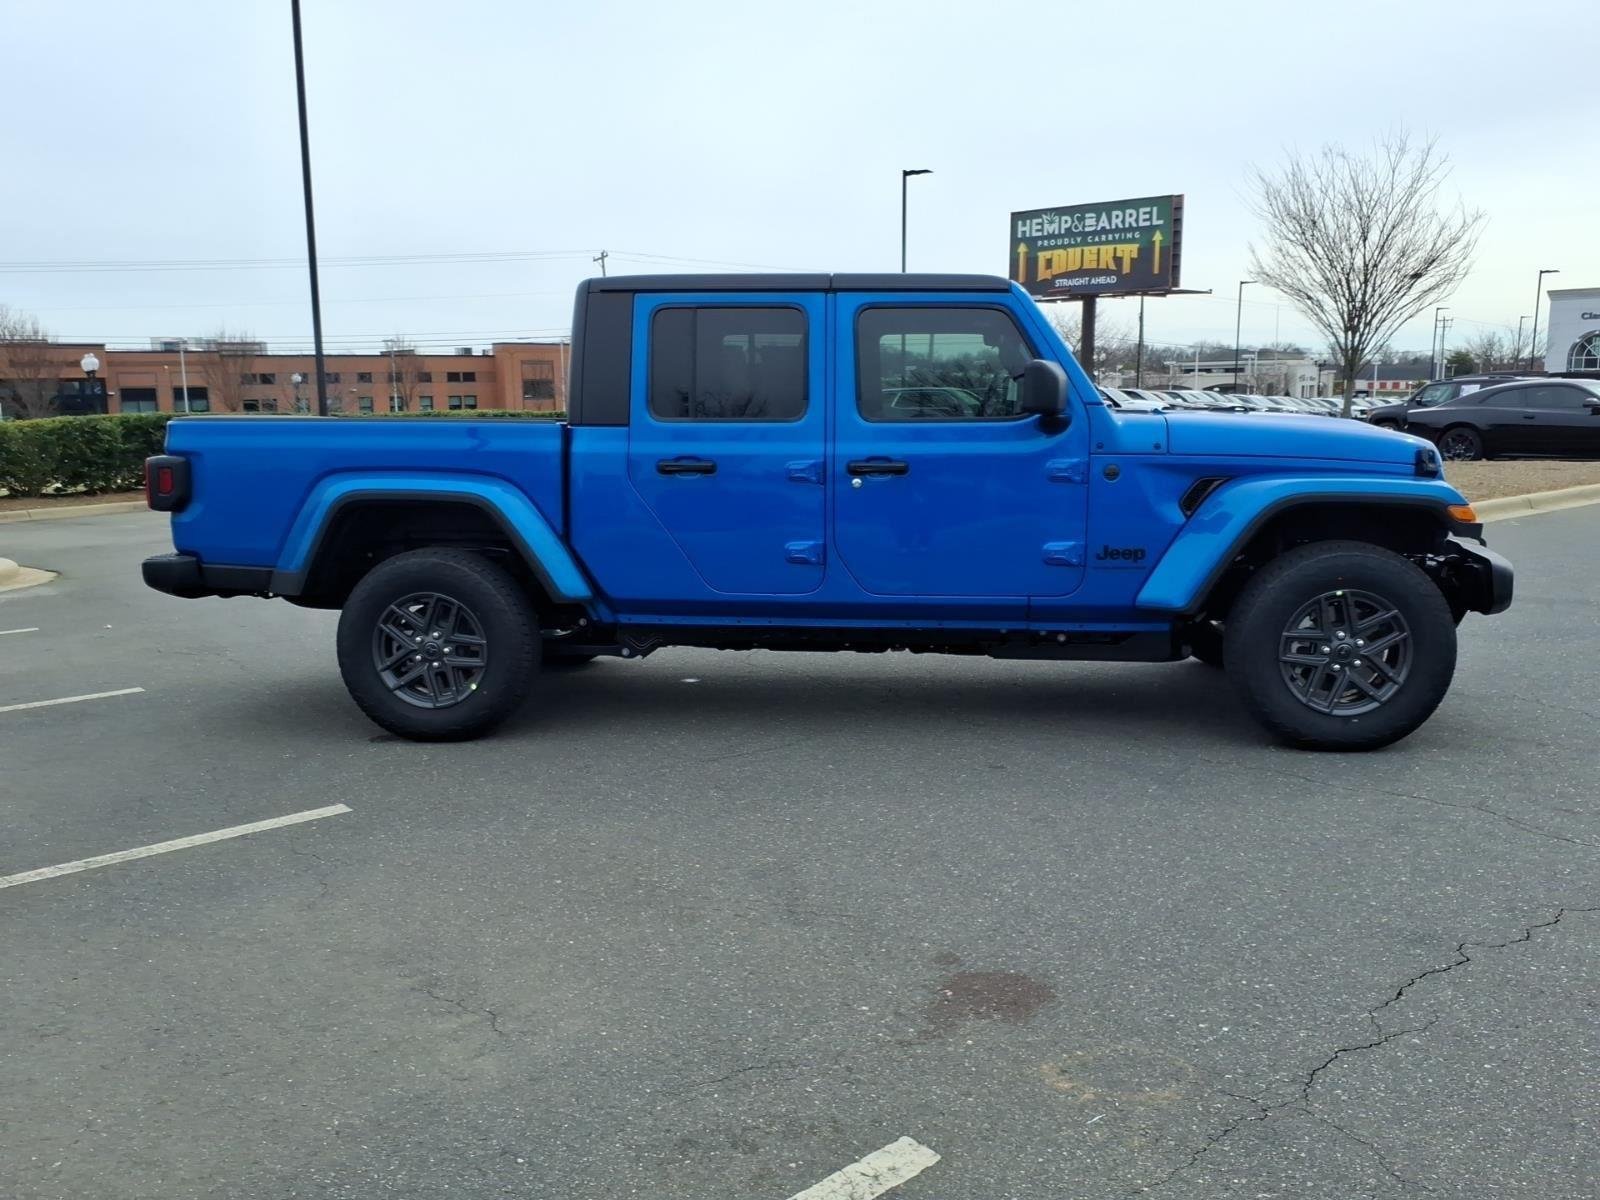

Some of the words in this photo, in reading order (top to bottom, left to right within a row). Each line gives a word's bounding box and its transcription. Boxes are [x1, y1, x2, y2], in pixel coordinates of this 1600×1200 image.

[1037, 237, 1082, 247] PROUDLY
[1087, 231, 1140, 242] CARRYING
[1055, 278, 1090, 288] STRAIGHT
[1090, 275, 1117, 286] AHEAD
[1096, 544, 1146, 563] Jeep
